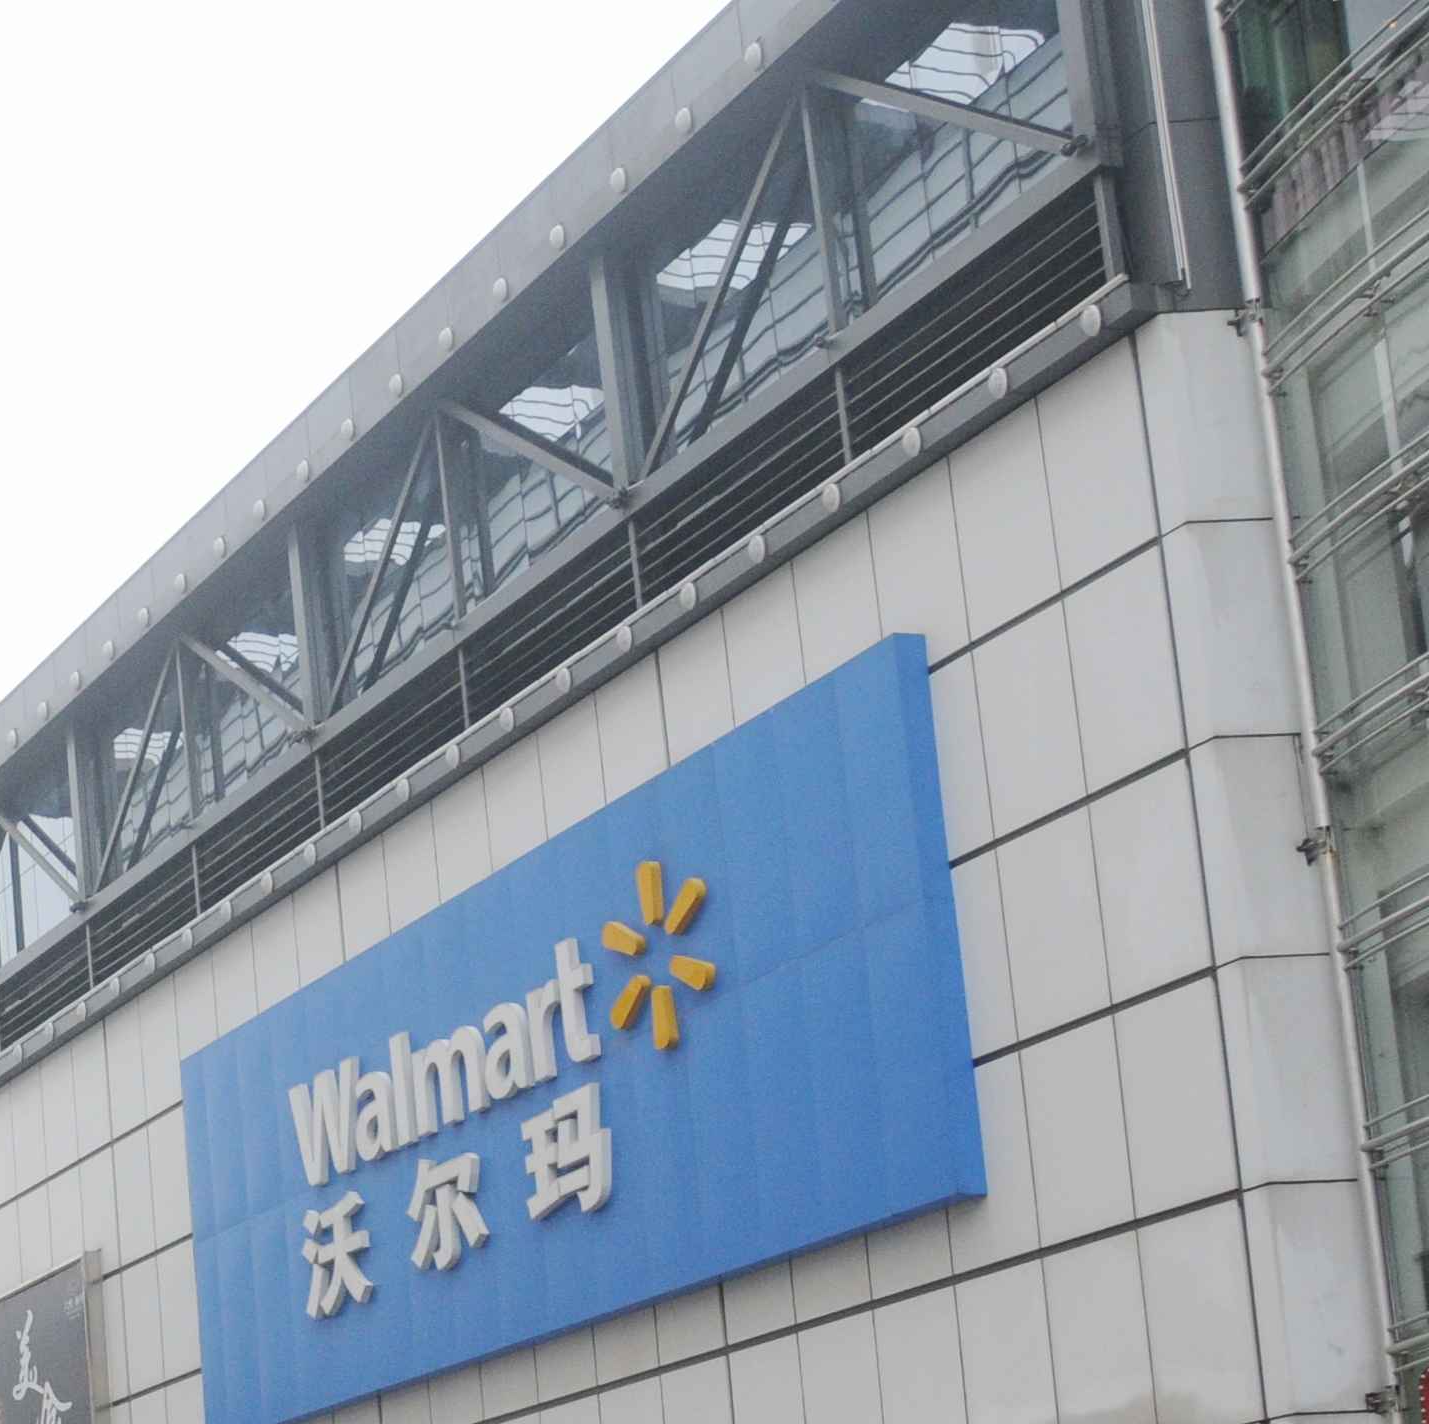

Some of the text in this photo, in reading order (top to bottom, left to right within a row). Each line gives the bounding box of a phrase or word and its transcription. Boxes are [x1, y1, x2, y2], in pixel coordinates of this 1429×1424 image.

[289, 937, 603, 1187] Walmart
[302, 1082, 613, 1321] 沃尔玛
